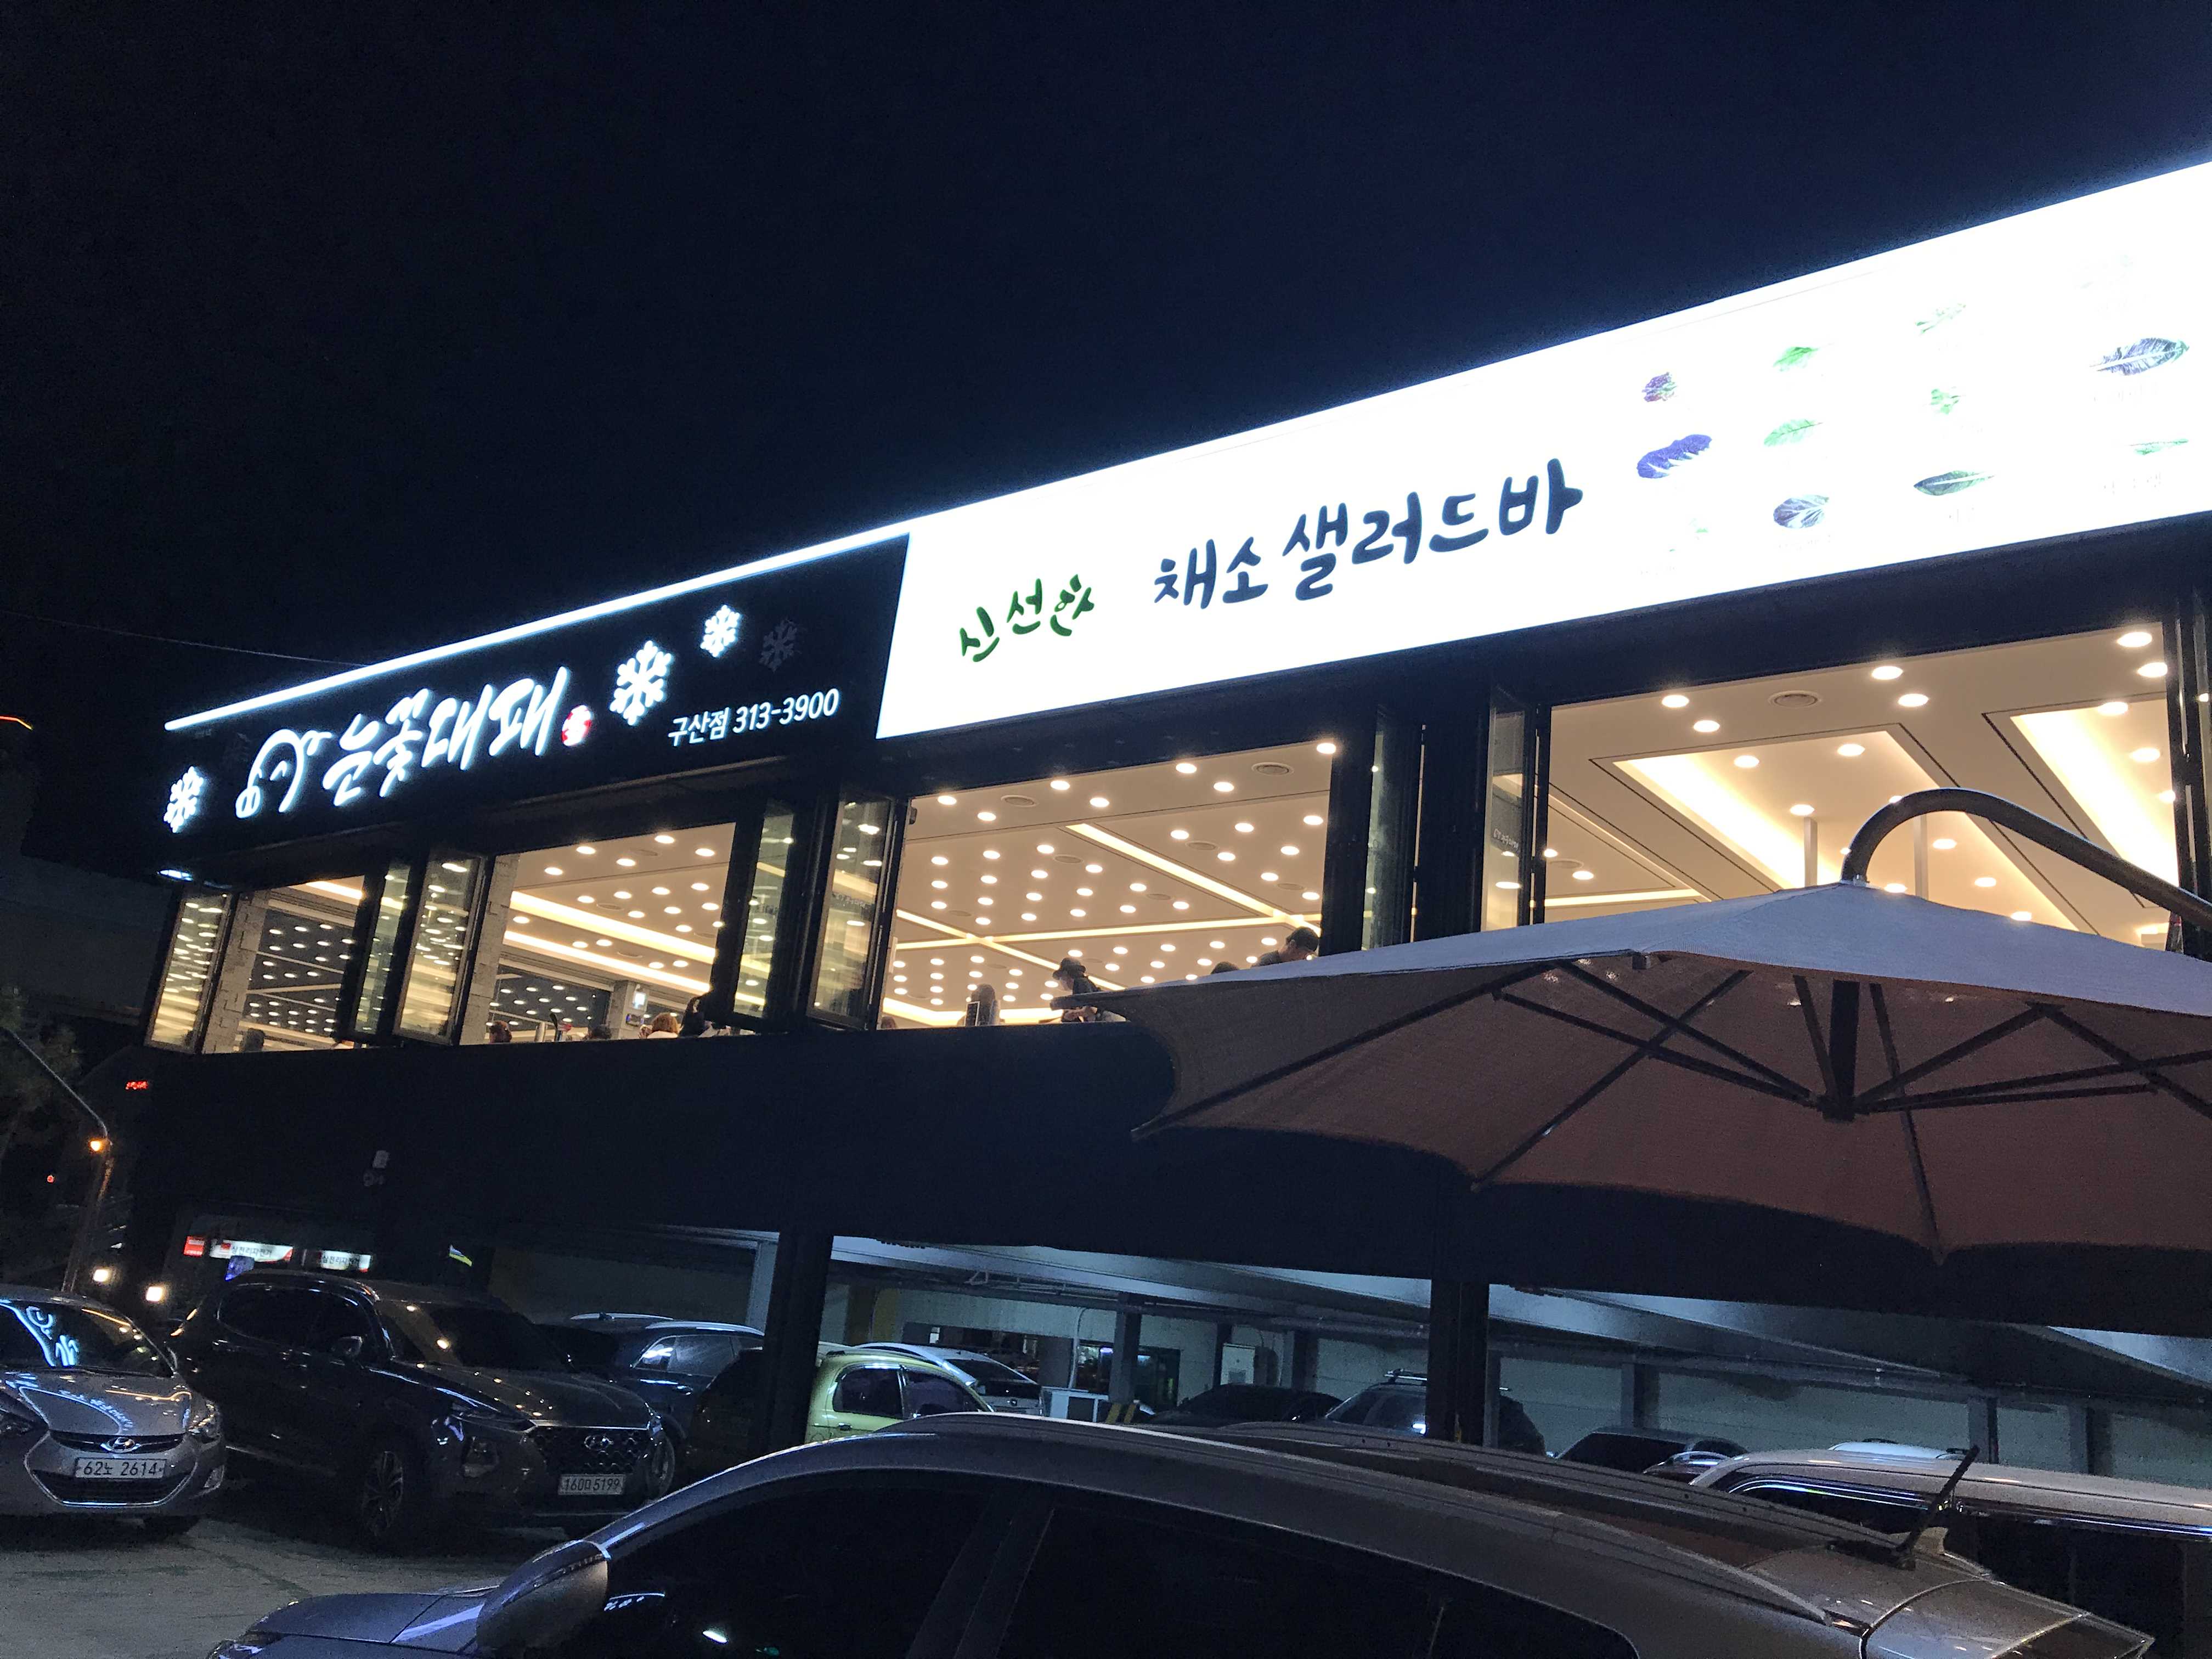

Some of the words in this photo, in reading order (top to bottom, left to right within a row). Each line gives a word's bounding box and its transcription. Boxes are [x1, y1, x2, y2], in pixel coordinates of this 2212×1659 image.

[960, 574, 1094, 663] 신선한
[1154, 537, 1268, 610] 채소
[1282, 458, 1583, 601] 샐러드바
[323, 666, 568, 806] 눈꽃대패
[668, 707, 730, 747] 구산점
[732, 688, 839, 733] 313-3900
[120, 1462, 157, 1476] 2614
